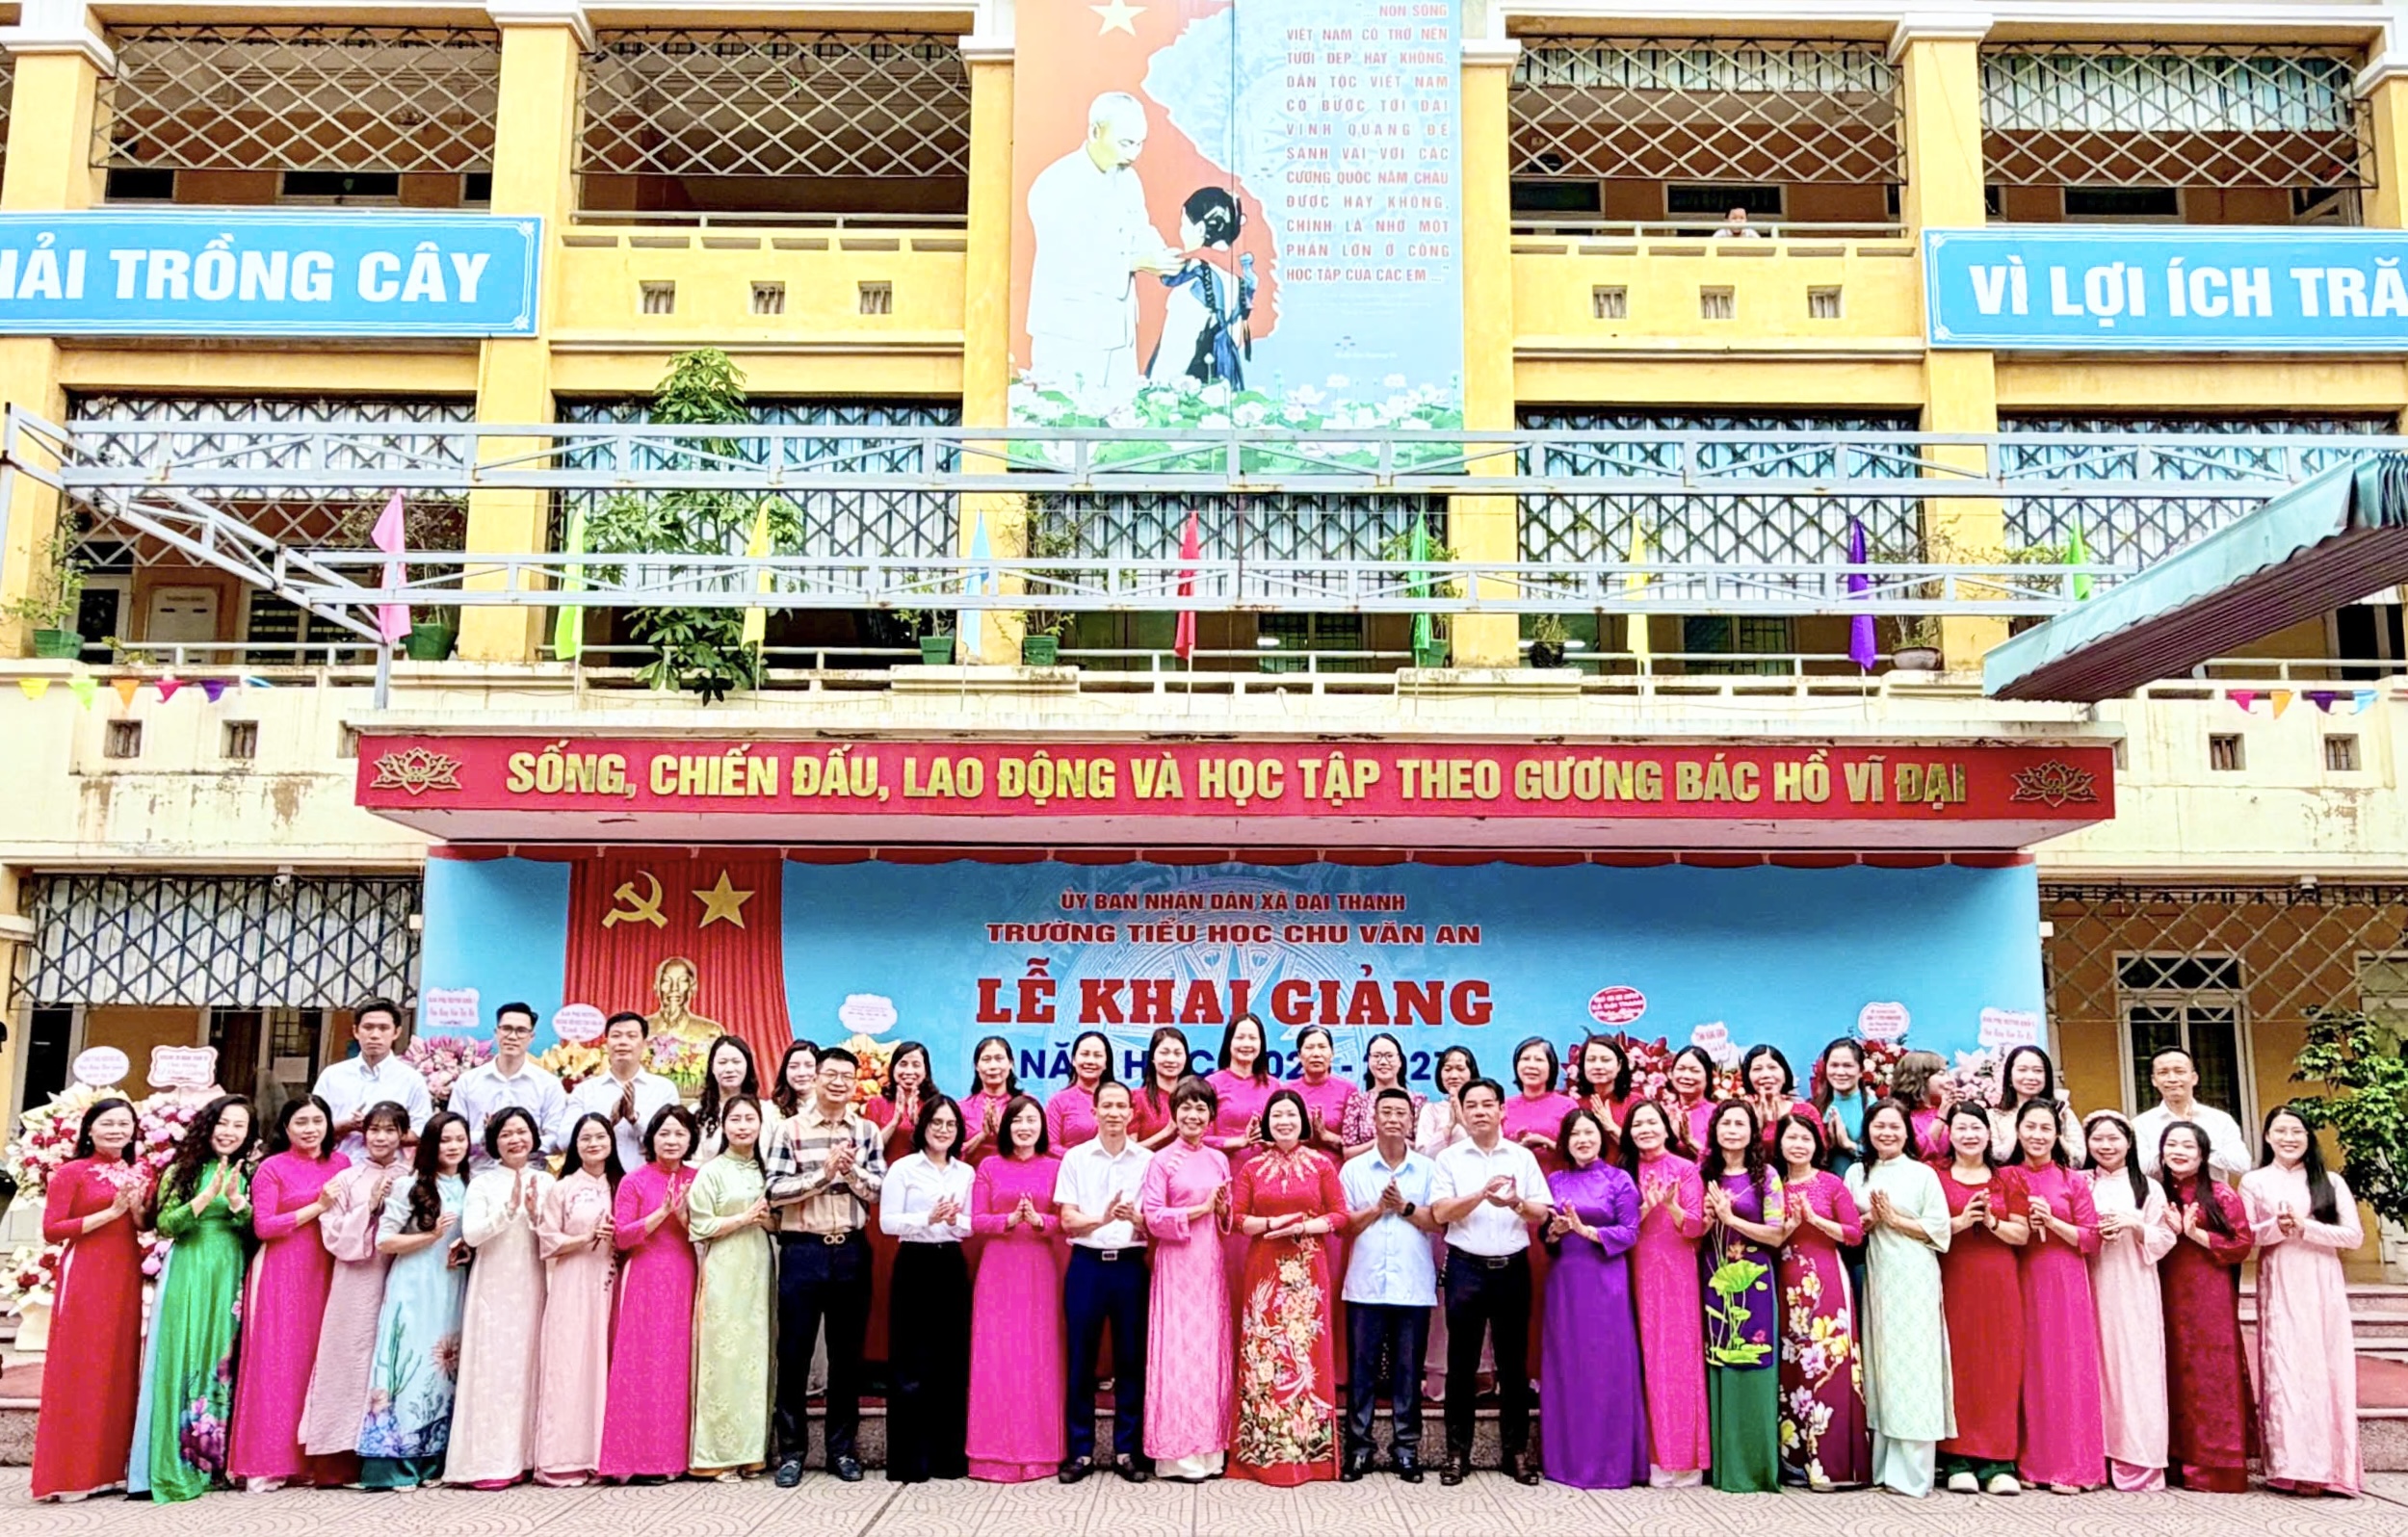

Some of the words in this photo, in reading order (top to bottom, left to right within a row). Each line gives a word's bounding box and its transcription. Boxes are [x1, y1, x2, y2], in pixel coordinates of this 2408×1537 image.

[1379, 5, 1406, 16] NON
[1322, 29, 1351, 40] NAM
[1364, 52, 1387, 64] HAY
[1415, 76, 1448, 88] NAM
[1287, 123, 1331, 136] VINH
[1348, 123, 1410, 137] QUANG
[1342, 147, 1366, 160] VAI
[1344, 195, 1373, 208] HAY
[109, 232, 334, 303] TRỒNG
[357, 240, 491, 303] CÂY
[1406, 269, 1426, 281] EM
[1969, 254, 2028, 315] VÌ
[2050, 261, 2145, 327] LỢI
[2167, 256, 2273, 318] ÍCH
[506, 740, 637, 799] SỐNG,
[649, 743, 778, 796] CHIẾN
[792, 743, 889, 802] ĐẤU,
[903, 756, 984, 797] LAO
[997, 749, 1116, 806] ĐỘNG
[1130, 751, 1184, 798] VÀ
[1198, 758, 1284, 806] HỌC
[1297, 750, 1380, 806] TẬP
[1396, 759, 1501, 799] THEO
[1514, 755, 1662, 801] GƯƠNG
[1676, 752, 1759, 801] BÁC
[1774, 748, 1830, 802] HỒ
[1844, 754, 1887, 802] VĨ
[1894, 762, 1966, 810] ĐẠI
[1060, 887, 1087, 909] ỦY
[1094, 893, 1138, 909] BAN
[1144, 890, 1204, 910] NHÂN
[1211, 890, 1253, 909] DÂN
[1261, 890, 1289, 910] XÃ
[1295, 893, 1329, 913] ĐẠI
[1336, 894, 1405, 910] THANH
[986, 919, 1115, 942] TRƯỜNG
[1128, 917, 1196, 943] TIỂU
[1208, 925, 1271, 947] HỌC
[1284, 925, 1348, 943] CHU
[1359, 921, 1424, 944] VĂN
[1435, 925, 1480, 944] AN
[977, 957, 1056, 1024] LỄ
[1079, 978, 1251, 1025] KHAI
[1270, 964, 1493, 1026] GIẢNG
[1125, 1049, 1216, 1080] HC
